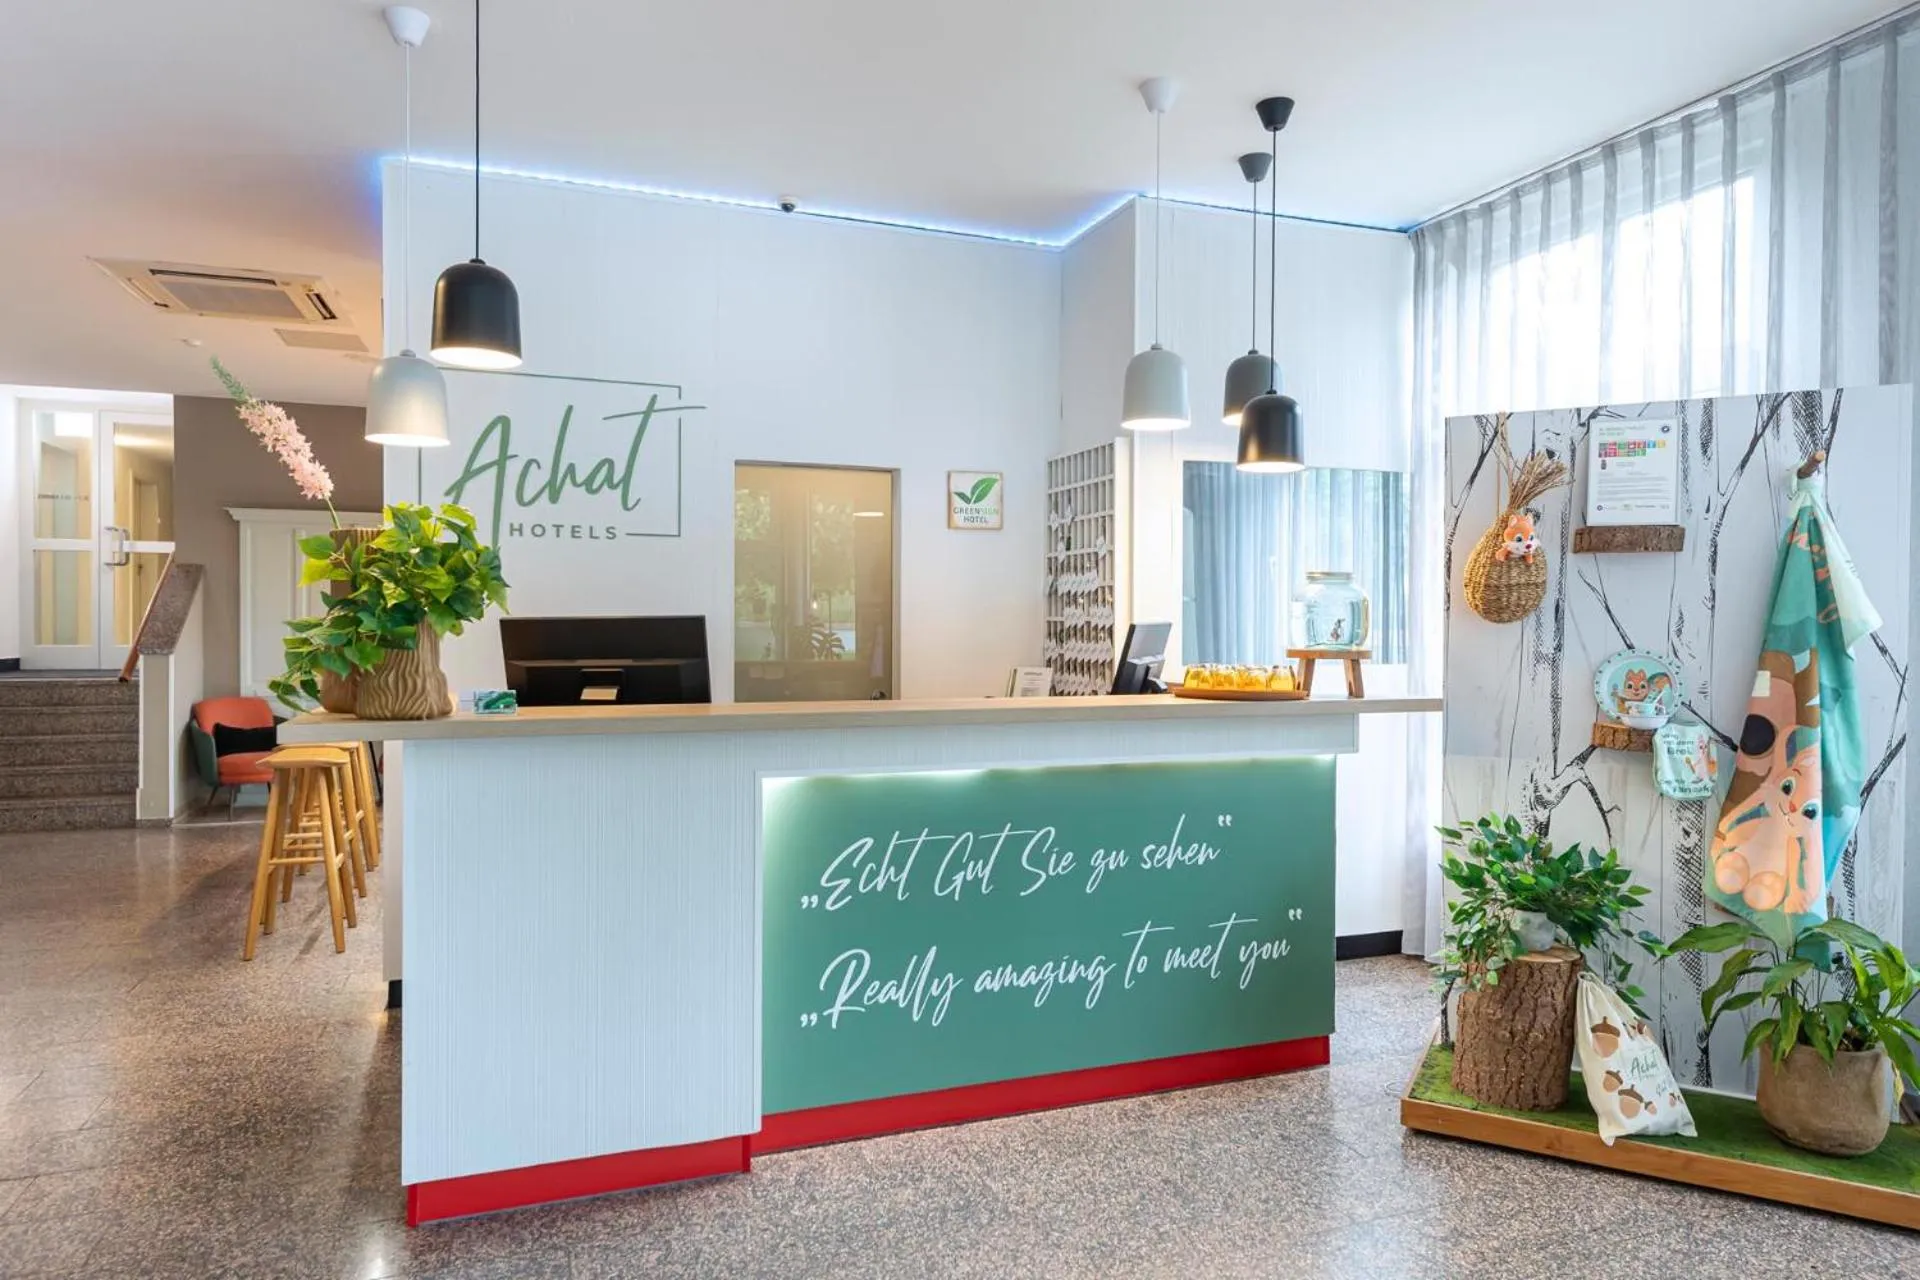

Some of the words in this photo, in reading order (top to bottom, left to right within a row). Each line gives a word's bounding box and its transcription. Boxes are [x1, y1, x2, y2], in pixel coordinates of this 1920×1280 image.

[444, 394, 707, 549] Achat
[509, 523, 617, 540] HOTELS
[934, 823, 1037, 900] Gut
[1020, 827, 1076, 896] Sie
[1086, 850, 1129, 893] zu
[974, 955, 1117, 1009] amazing
[1122, 920, 1175, 989] to
[1163, 912, 1258, 979] meet
